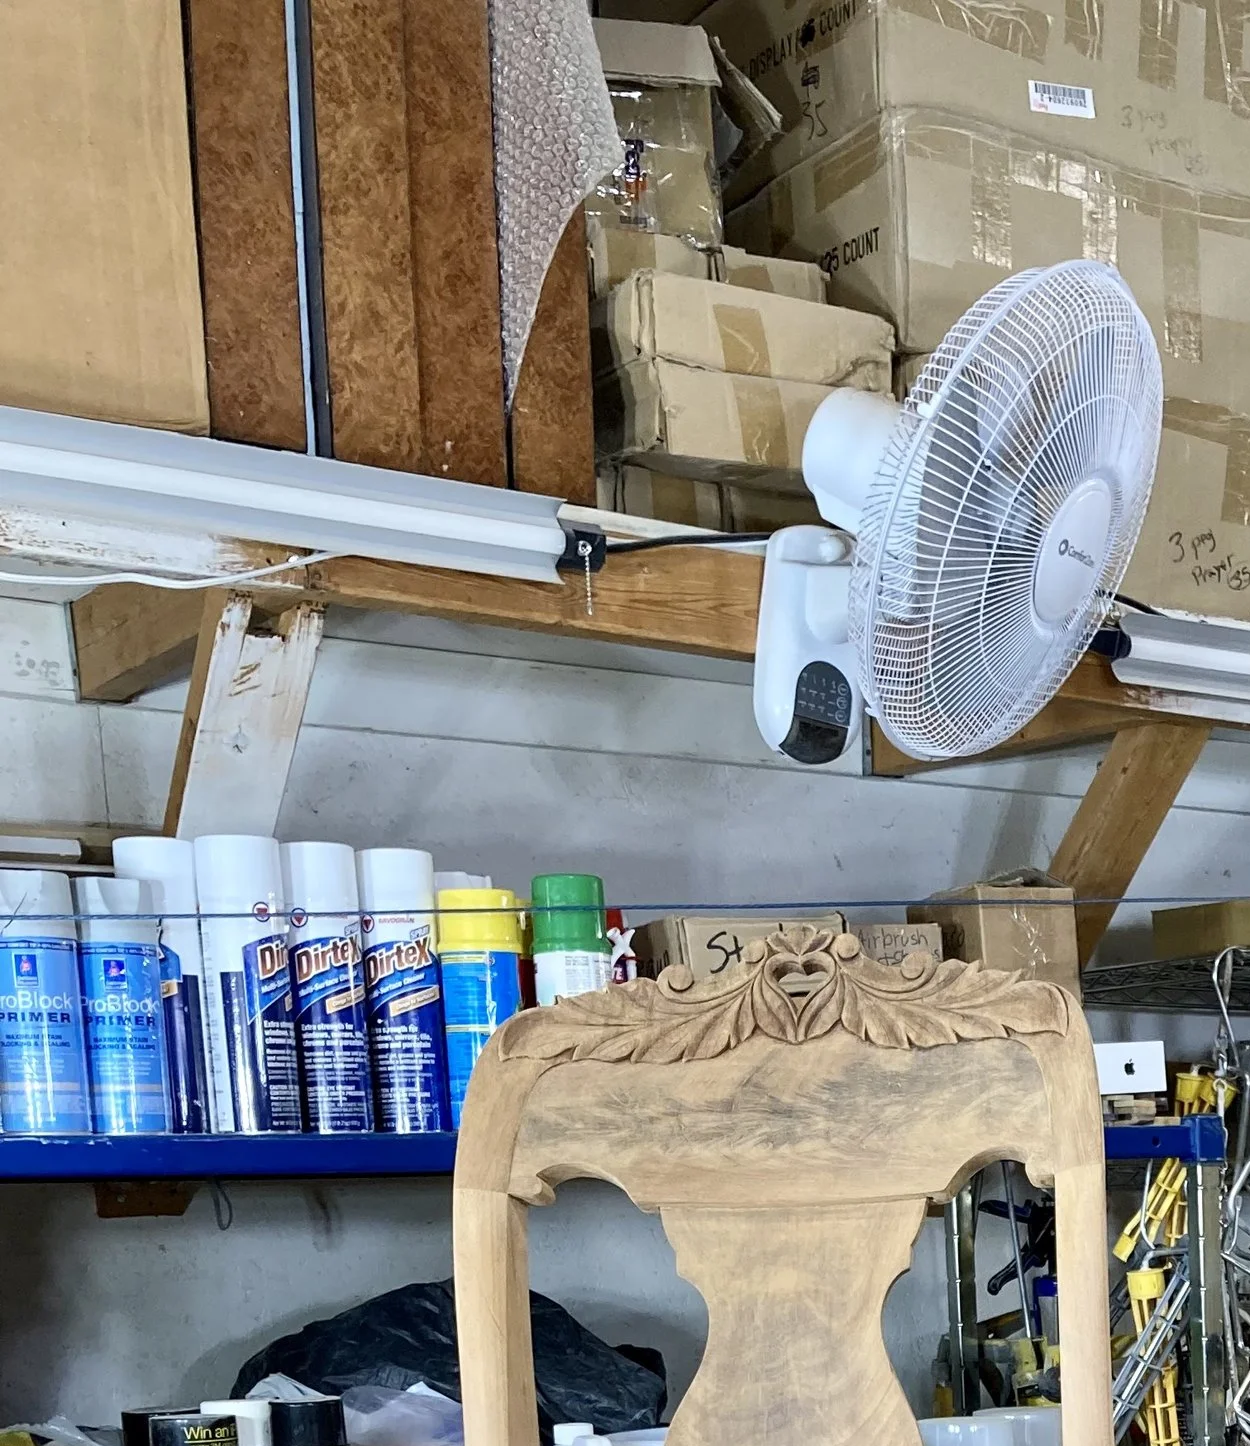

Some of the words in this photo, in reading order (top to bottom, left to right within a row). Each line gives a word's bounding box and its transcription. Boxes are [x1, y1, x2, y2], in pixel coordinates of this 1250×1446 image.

[842, 227, 881, 266] COUNT
[1168, 530, 1186, 564] 3
[858, 927, 929, 951] Airbrush
[183, 1425, 213, 1440] Win
